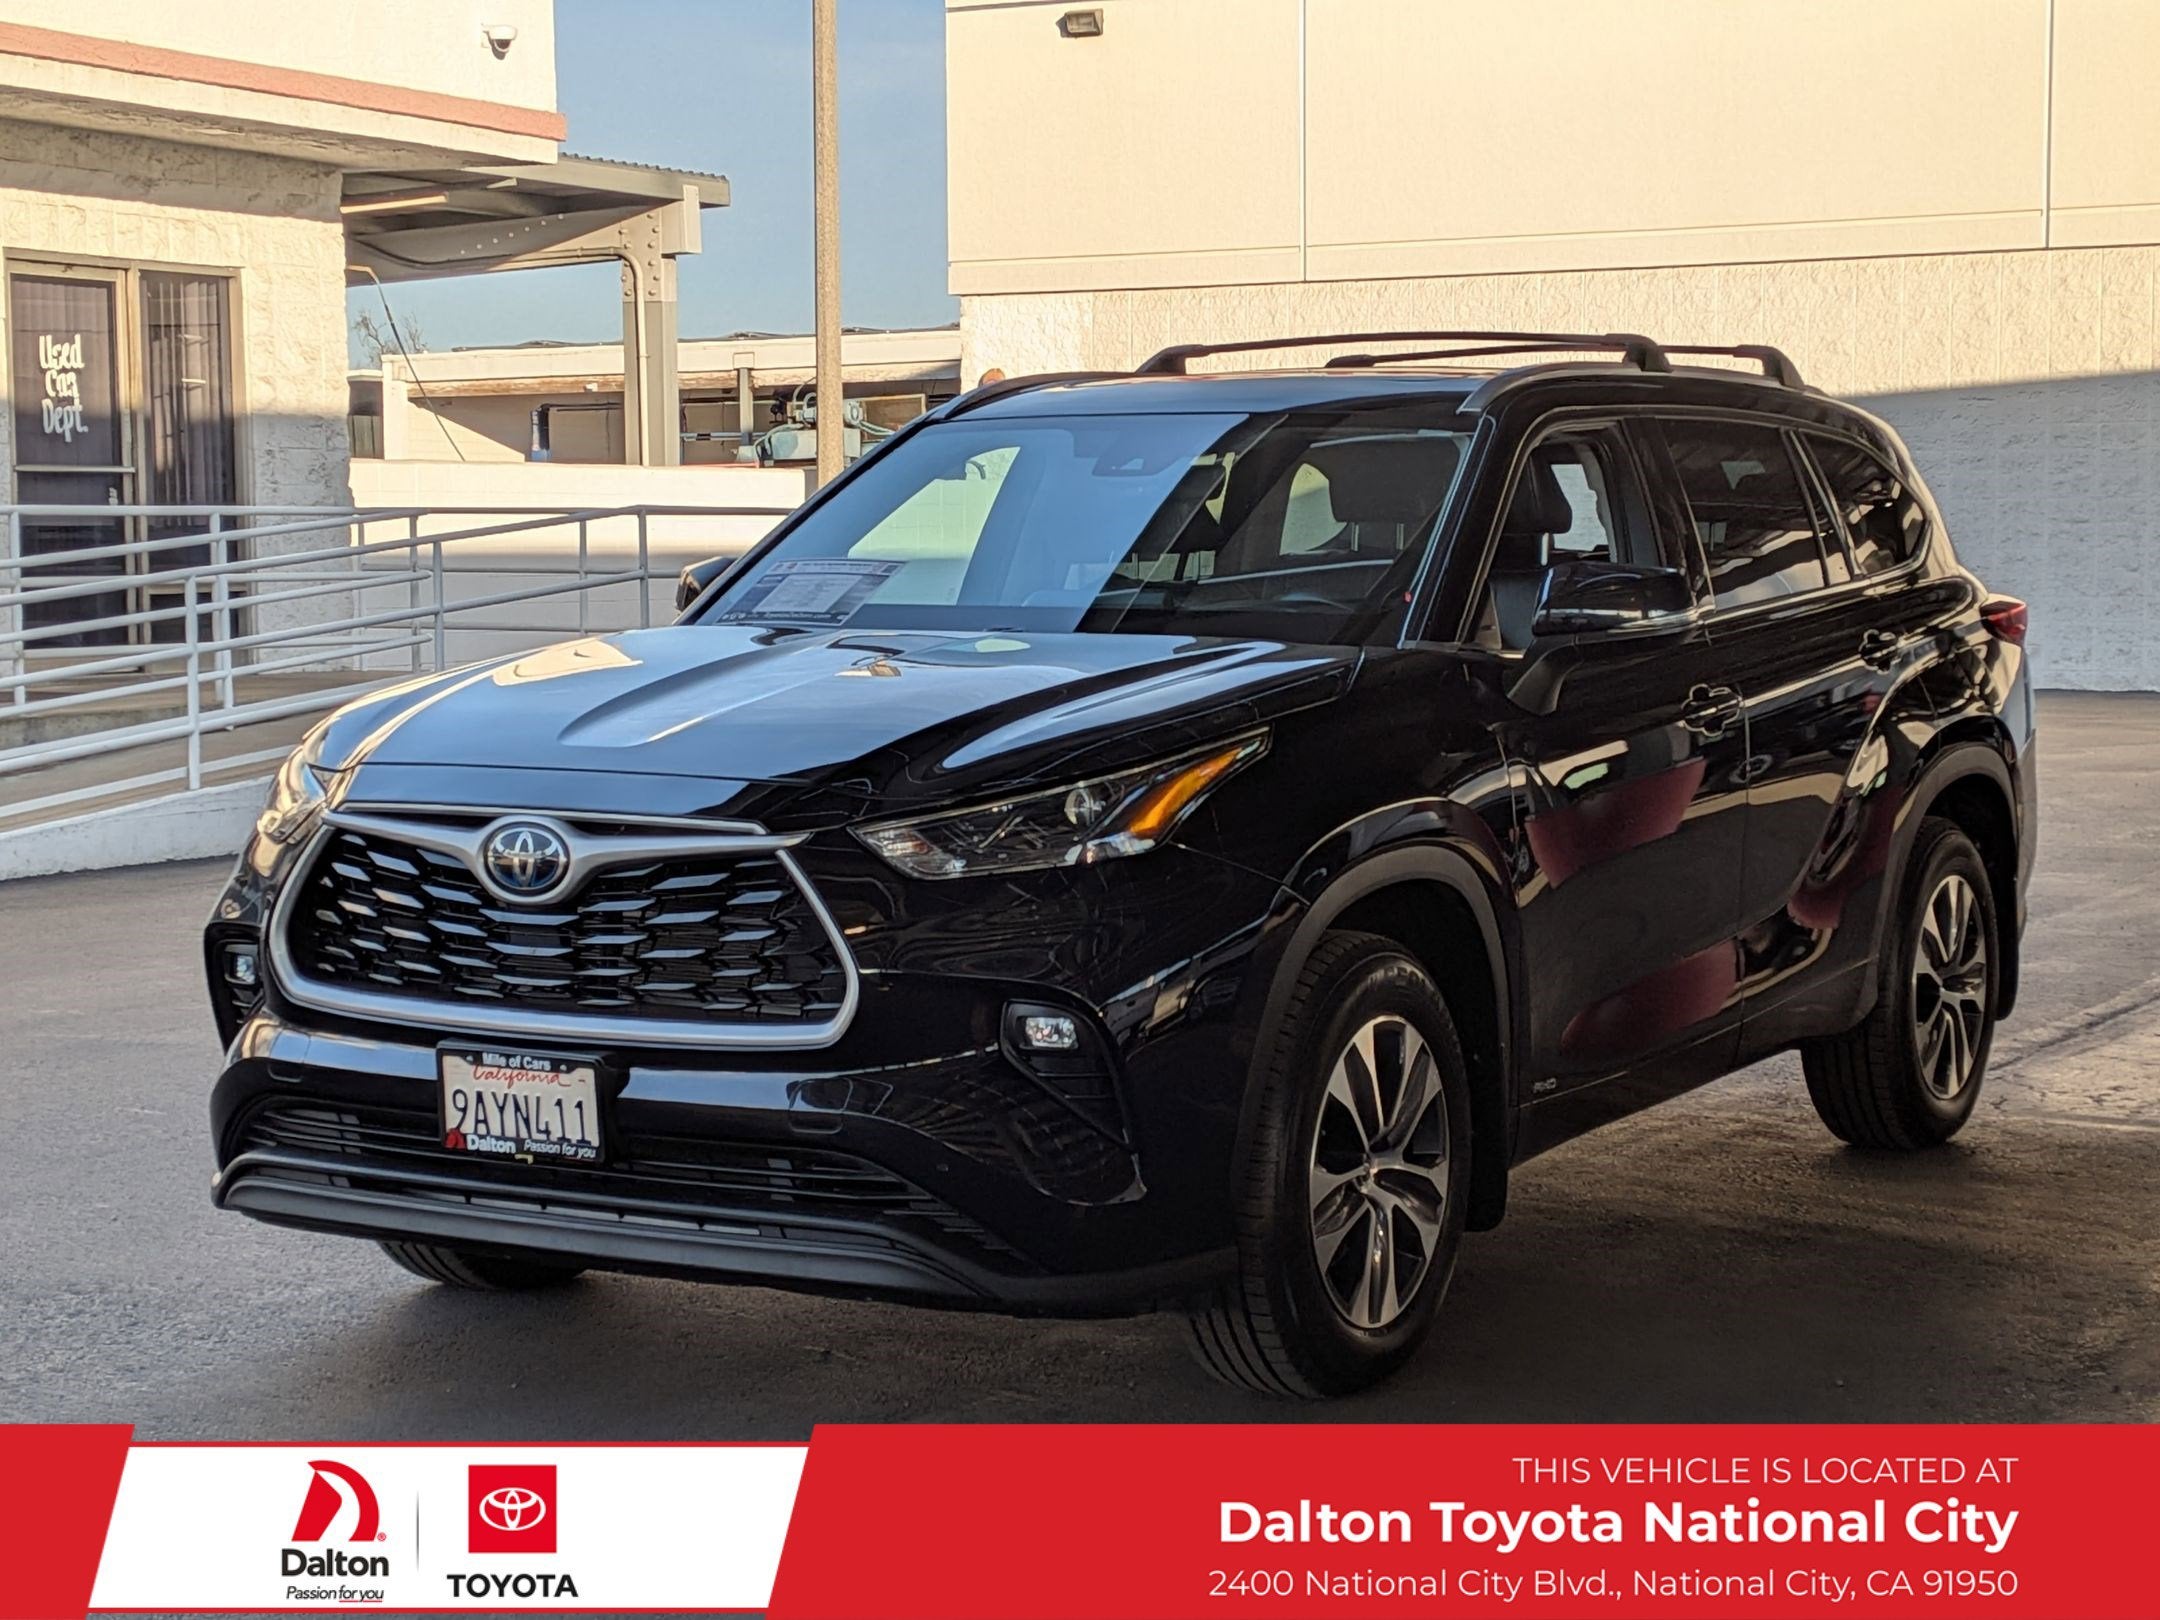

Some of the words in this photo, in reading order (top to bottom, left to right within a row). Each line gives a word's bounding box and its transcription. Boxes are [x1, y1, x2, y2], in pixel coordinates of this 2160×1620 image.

[39, 333, 85, 369] Used
[45, 370, 80, 398] Car
[41, 396, 89, 443] Dept.
[482, 1052, 507, 1067] Mile
[508, 1055, 521, 1068] of
[522, 1056, 552, 1071] Cars
[472, 1063, 572, 1089] California
[452, 1088, 592, 1147] 9AYN411
[466, 1134, 516, 1154] Dalton
[524, 1139, 561, 1154] Passion
[561, 1142, 576, 1156] for
[576, 1146, 596, 1159] you
